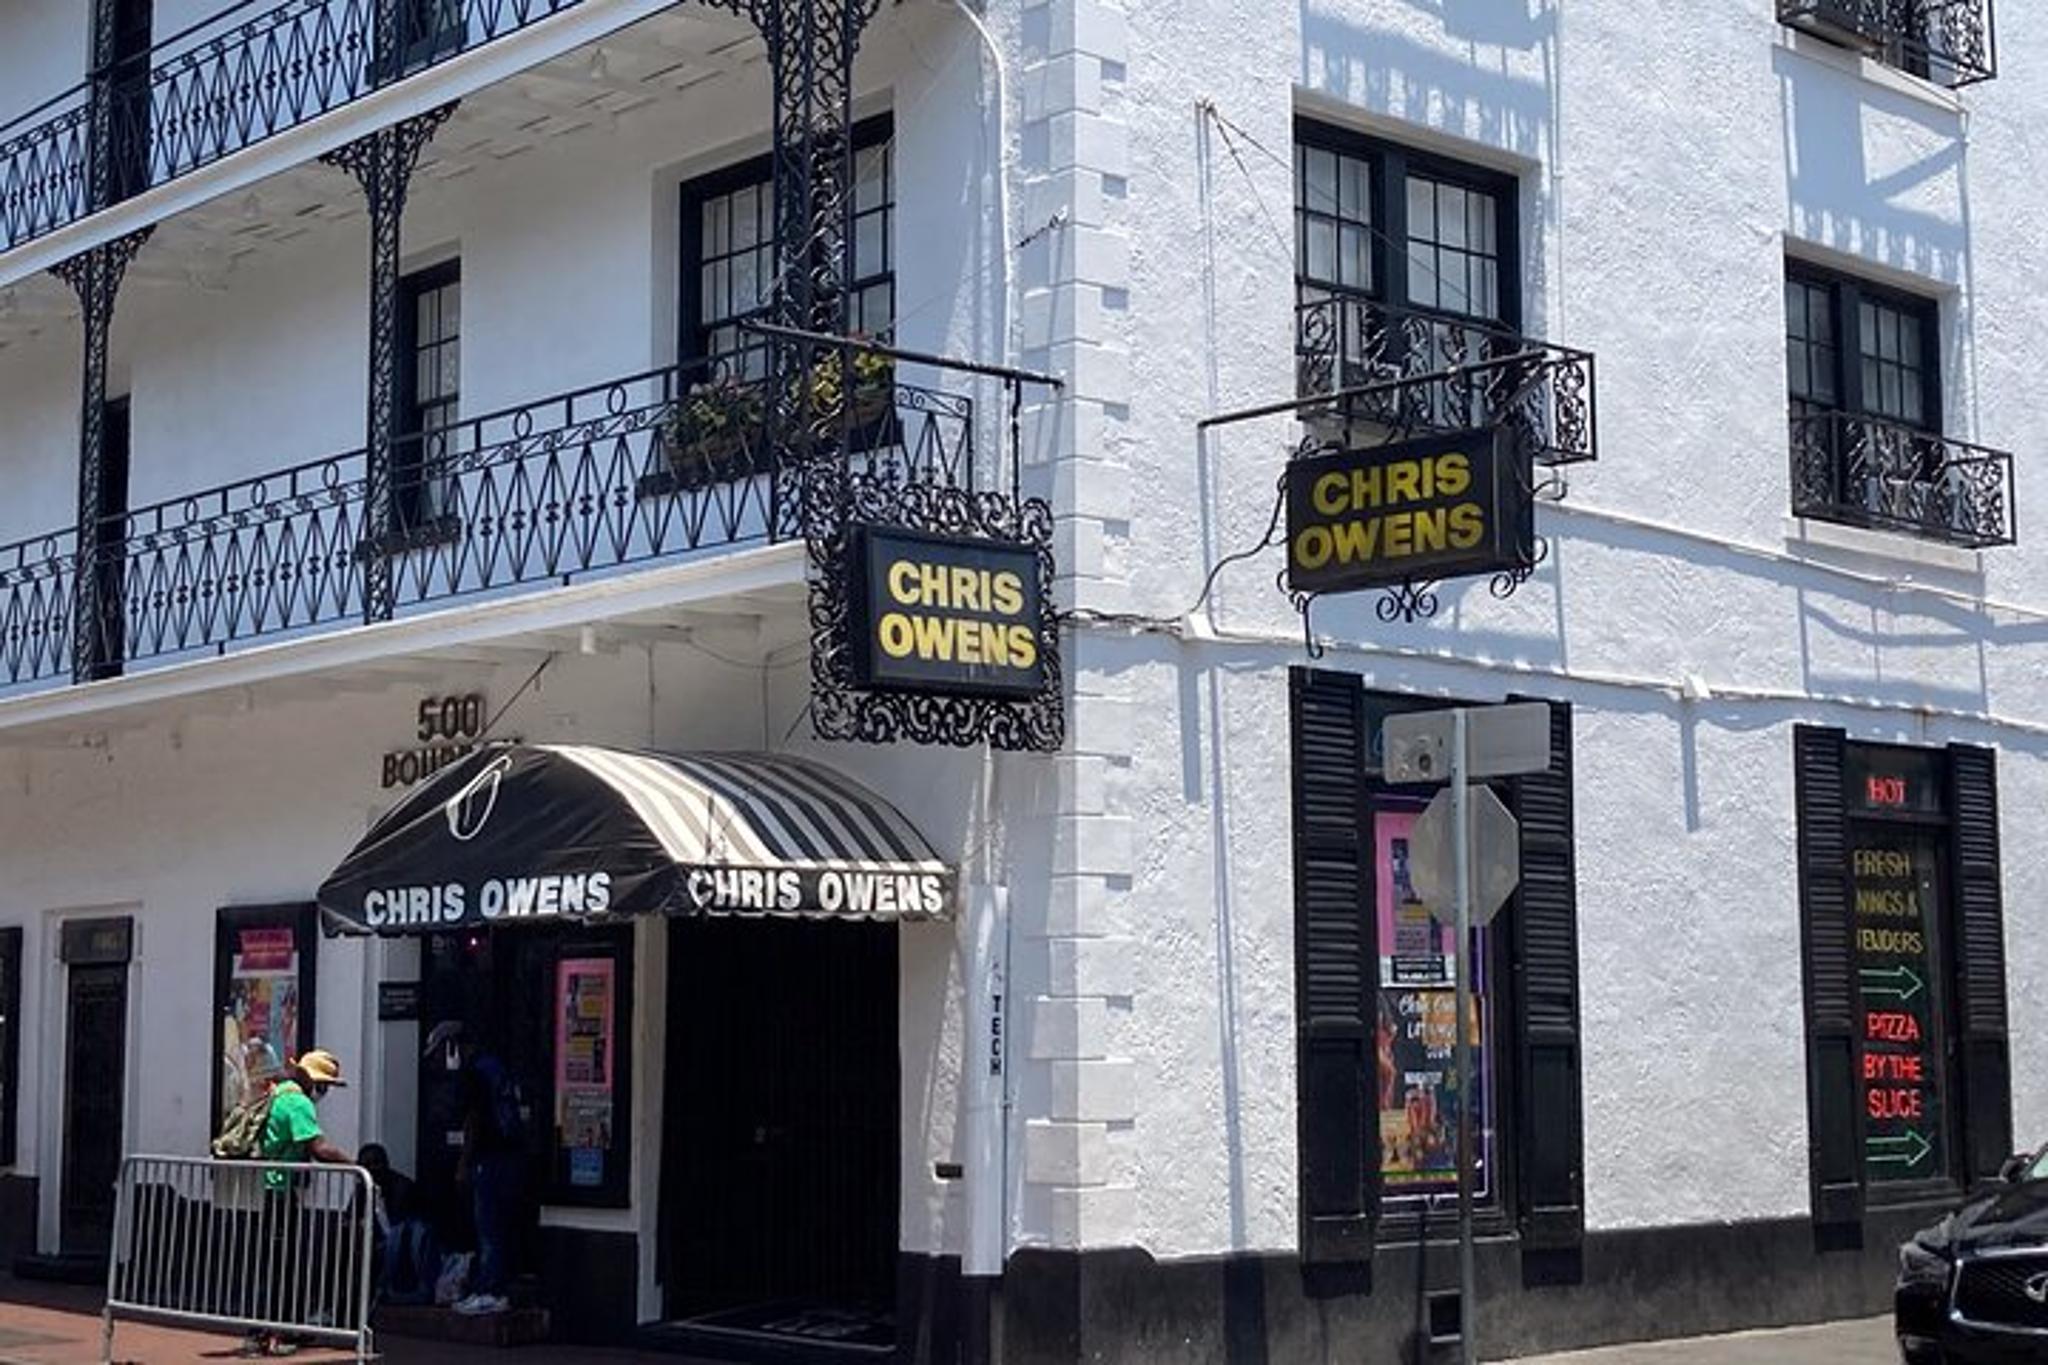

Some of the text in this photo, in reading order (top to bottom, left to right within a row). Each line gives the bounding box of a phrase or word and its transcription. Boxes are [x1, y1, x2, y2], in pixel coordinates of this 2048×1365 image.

[1313, 453, 1471, 516] CHRIS
[1295, 502, 1484, 569] OWENS
[889, 559, 1023, 615] CHRIS
[879, 612, 1037, 669] OWENS
[417, 693, 480, 741] 500
[1867, 777, 1906, 803] HOT
[1854, 850, 1911, 877] FRESH
[364, 871, 611, 926] CHRIS OWENS
[687, 869, 943, 914] CHRIS OWENS
[1867, 1012, 1920, 1041] PIZZA
[1864, 1054, 1923, 1081] BY THE
[1868, 1088, 1923, 1119] SLICE
